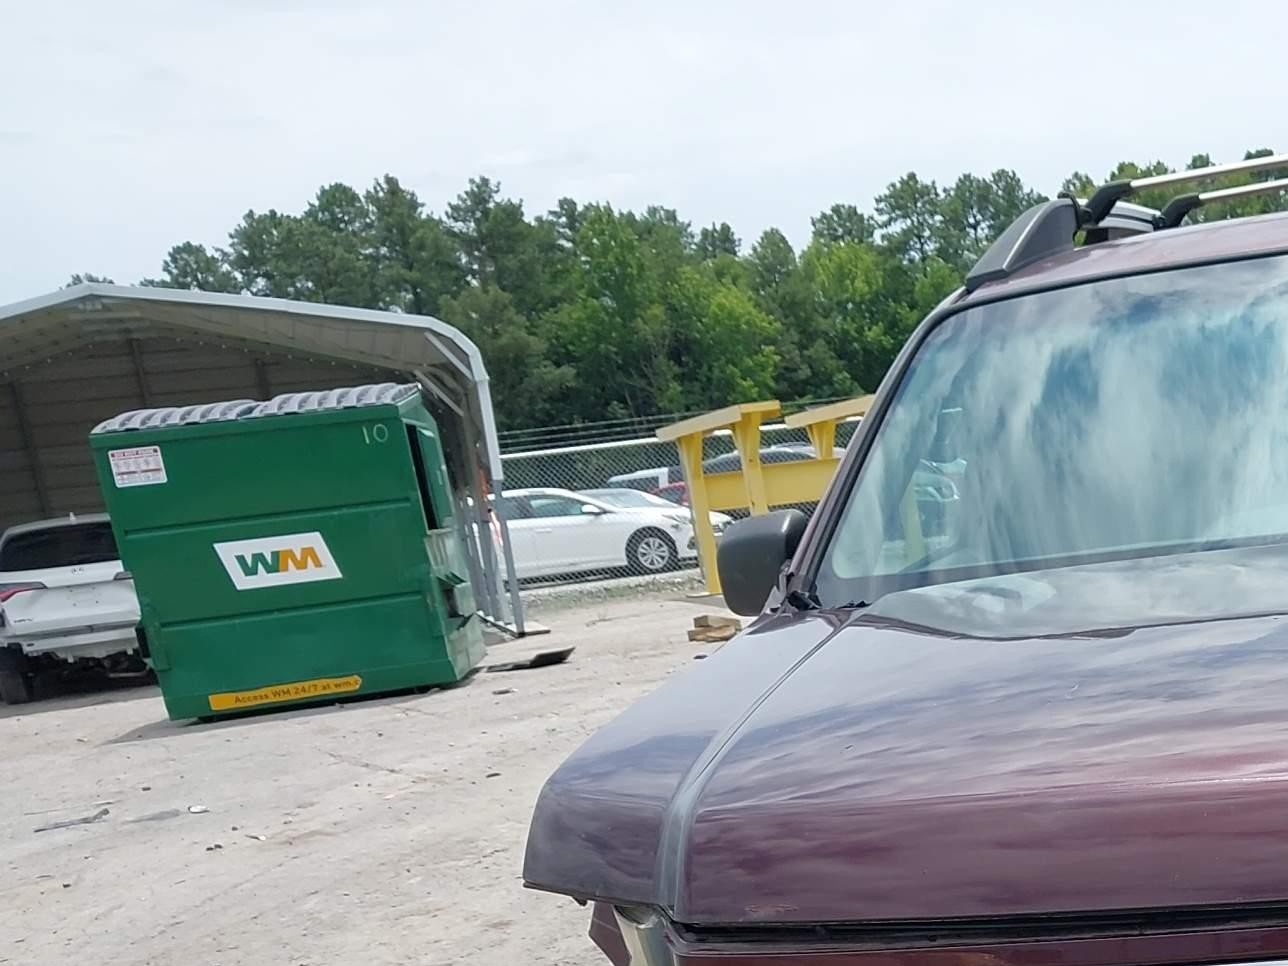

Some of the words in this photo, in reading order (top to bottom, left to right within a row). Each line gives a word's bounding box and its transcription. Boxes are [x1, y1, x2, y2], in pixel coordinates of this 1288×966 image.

[362, 423, 389, 444] 10
[234, 546, 322, 577] WM
[234, 693, 269, 704] Access
[272, 688, 290, 698] WM
[294, 685, 318, 696] 24/7
